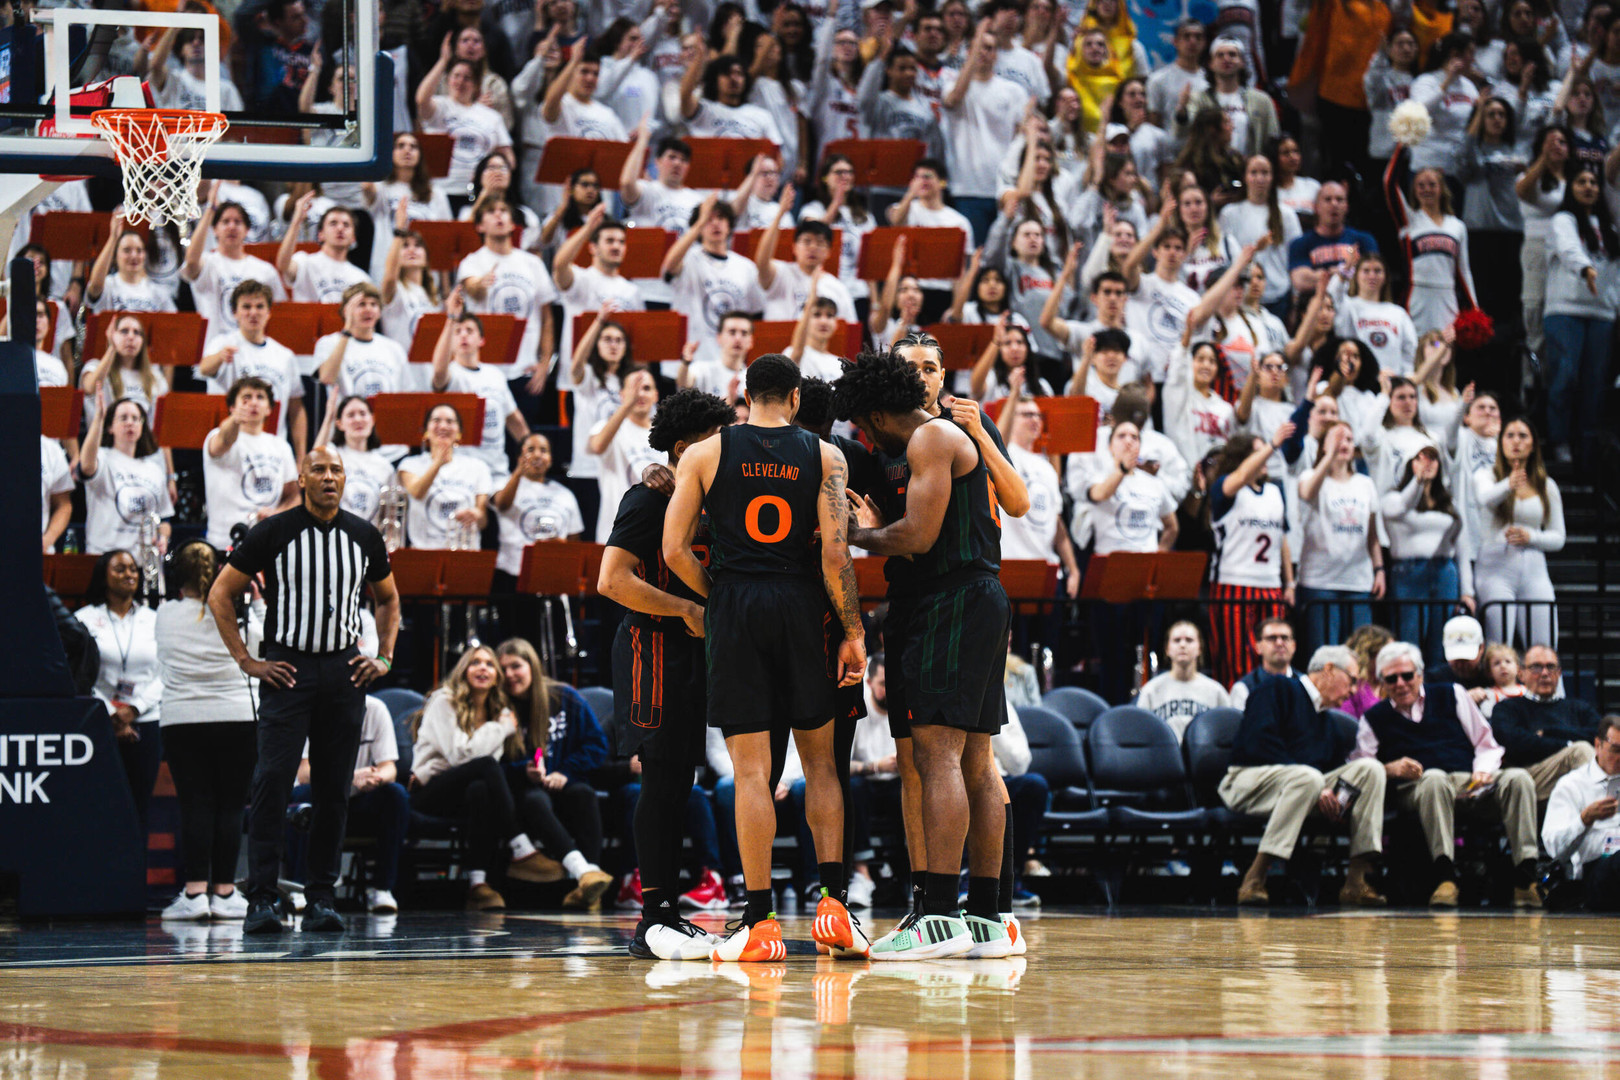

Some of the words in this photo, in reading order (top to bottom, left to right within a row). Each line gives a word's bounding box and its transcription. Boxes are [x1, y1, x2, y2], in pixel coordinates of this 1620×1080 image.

[742, 463, 800, 481] CLEVELAND
[745, 495, 792, 543] 0
[1254, 533, 1271, 563] 2
[0, 734, 94, 767] ITED
[0, 772, 50, 804] NK
